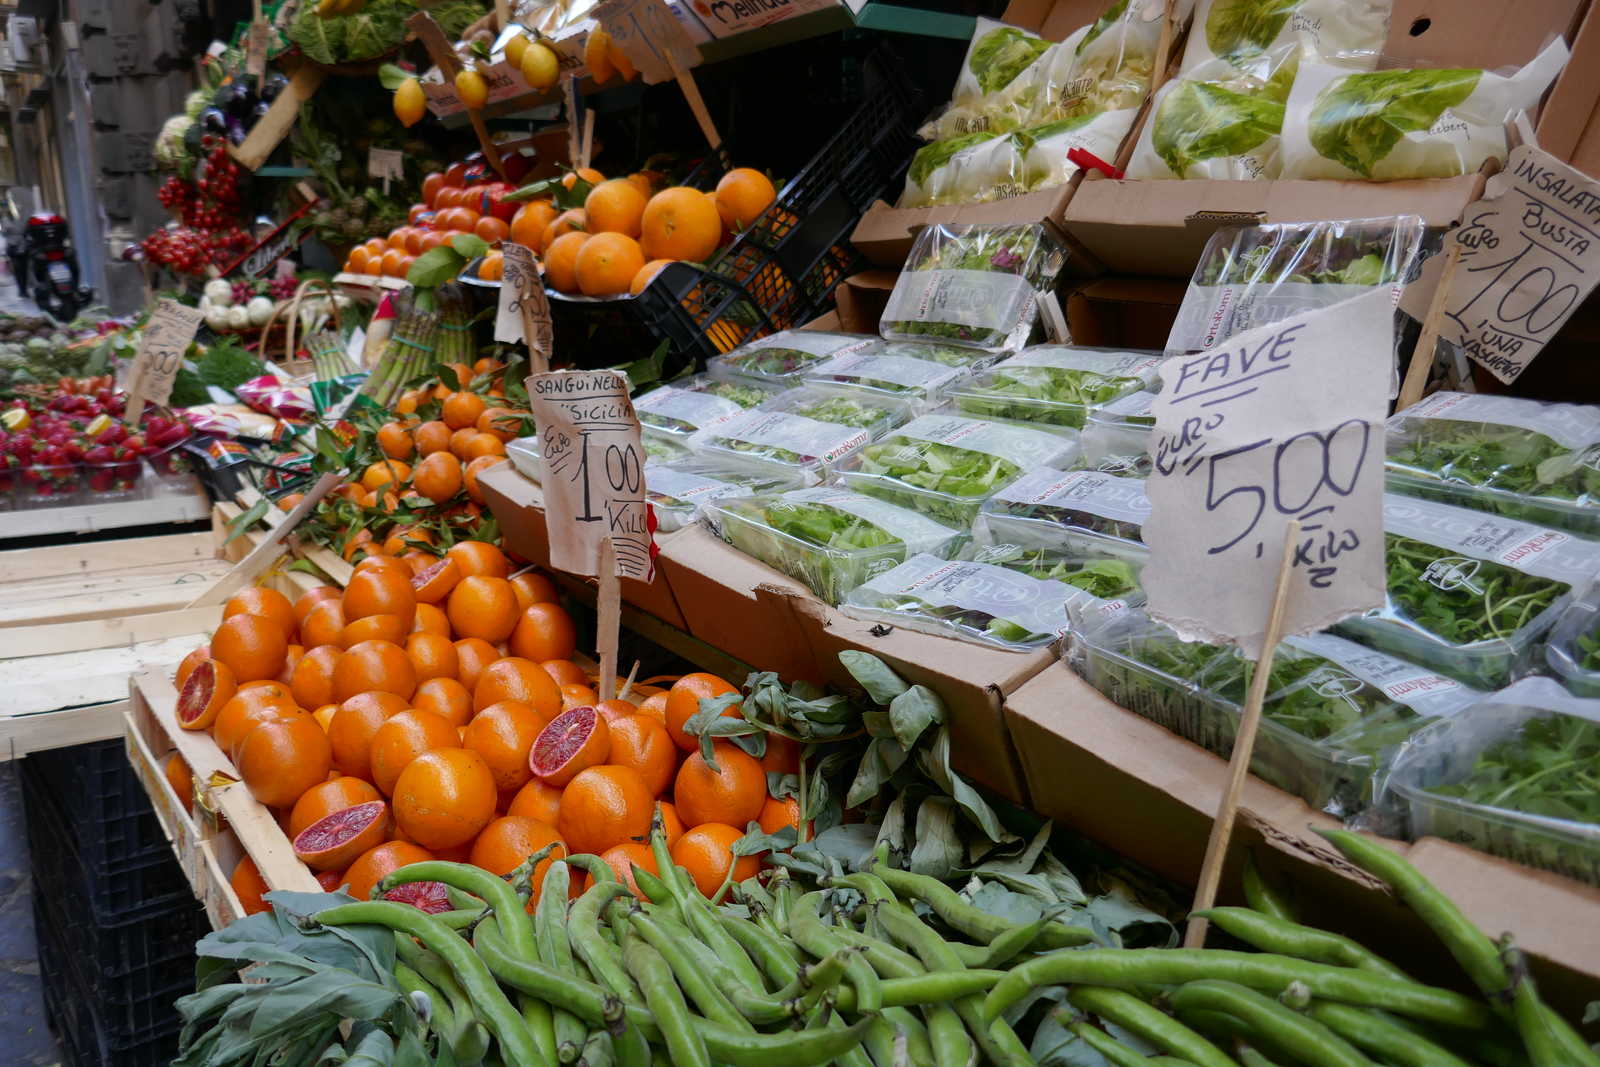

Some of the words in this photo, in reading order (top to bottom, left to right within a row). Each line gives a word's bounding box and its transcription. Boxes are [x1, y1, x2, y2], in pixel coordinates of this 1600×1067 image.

[1523, 202, 1591, 258] BUSTA
[1203, 287, 1233, 347] OrtoRomi
[1480, 331, 1523, 357] UNA
[1173, 323, 1306, 394] FAVE
[822, 431, 868, 466] OrtoRomi
